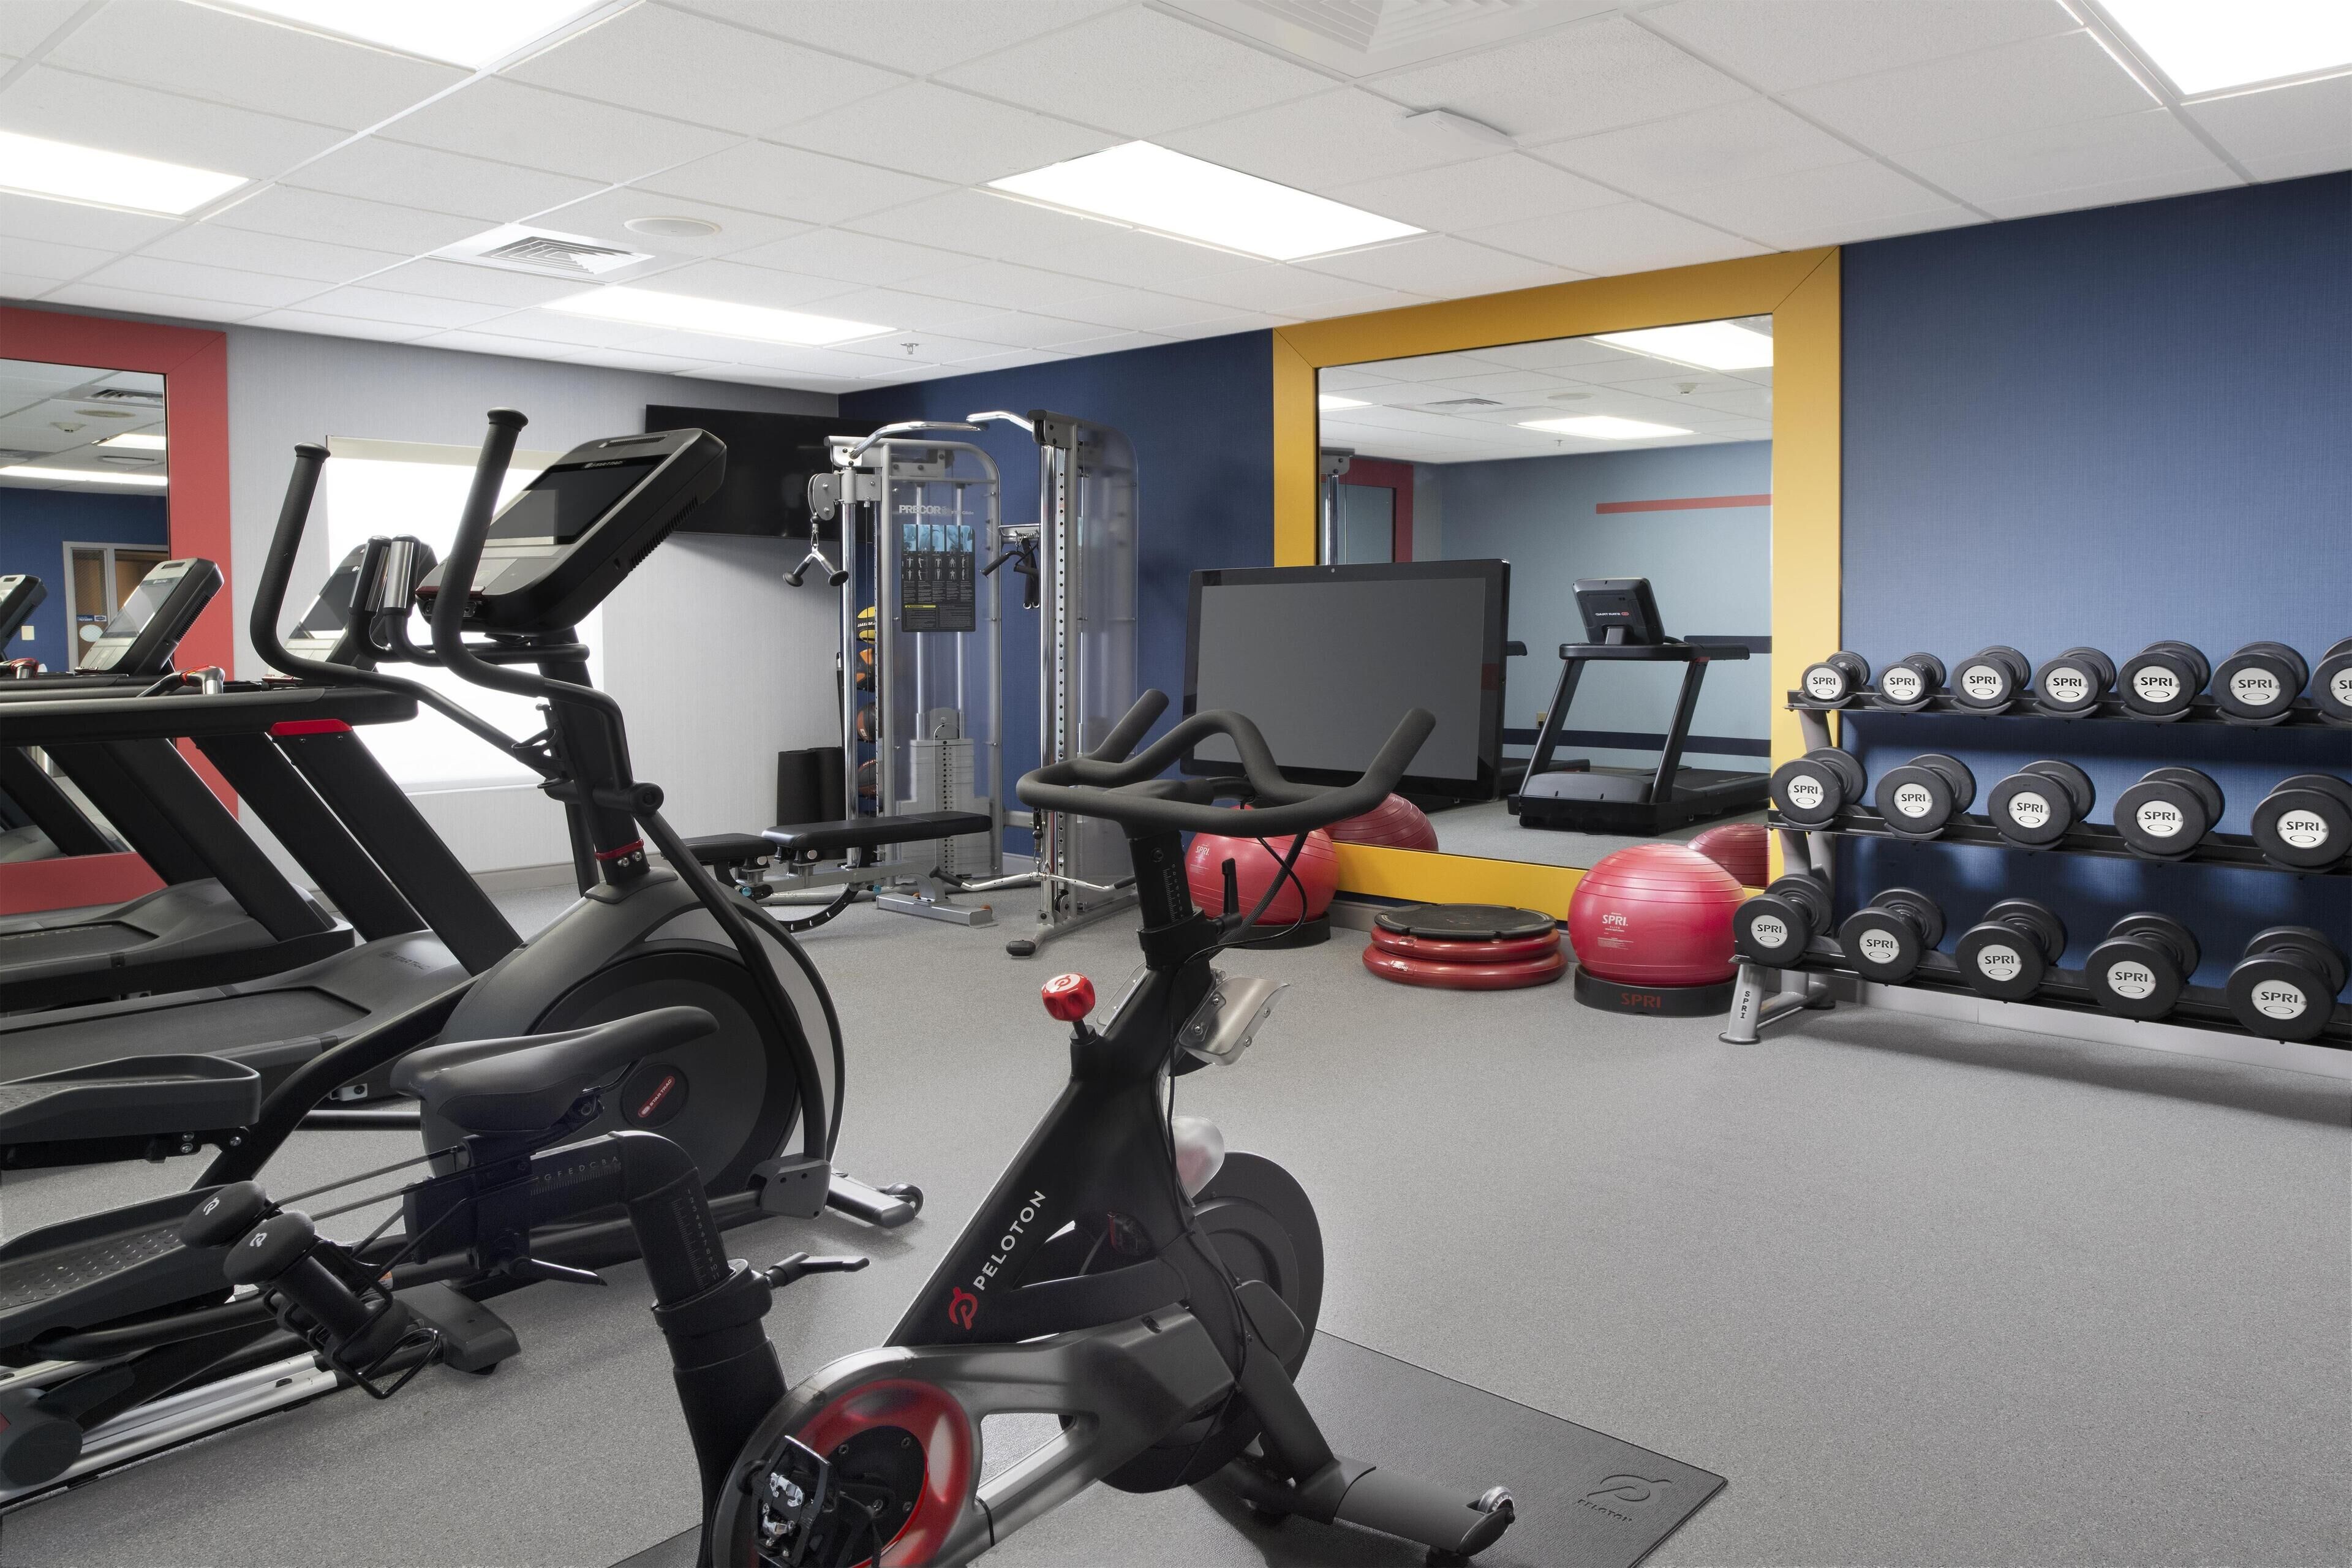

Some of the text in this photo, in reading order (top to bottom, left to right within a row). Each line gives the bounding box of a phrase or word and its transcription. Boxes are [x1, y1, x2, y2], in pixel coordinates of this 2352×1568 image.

[899, 504, 941, 514] PRECOR
[1812, 677, 1836, 685] SPRI
[1890, 677, 1915, 686] SPRI
[1969, 676, 1996, 685] SPRI
[2052, 677, 2082, 687] SPRI
[2140, 677, 2173, 687] SPRI
[2238, 679, 2272, 688] SPRI
[1793, 785, 1818, 794] SPRI
[1901, 793, 1926, 802] SPRI
[2016, 802, 2043, 813] SPRI
[2144, 811, 2176, 821] SPRI
[2286, 821, 2319, 831] SPRI
[1757, 924, 1782, 933] SPRI
[1866, 938, 1893, 949] SPRI
[1985, 955, 2015, 965] SPRI
[2114, 971, 2148, 982] SPRI
[1621, 993, 1661, 1008] SPRI
[2260, 991, 2298, 1003] SPRI
[1740, 990, 1751, 1019] SPRI
[650, 1079, 672, 1106] STAR TRAC
[973, 1190, 1046, 1291] PELOTON
